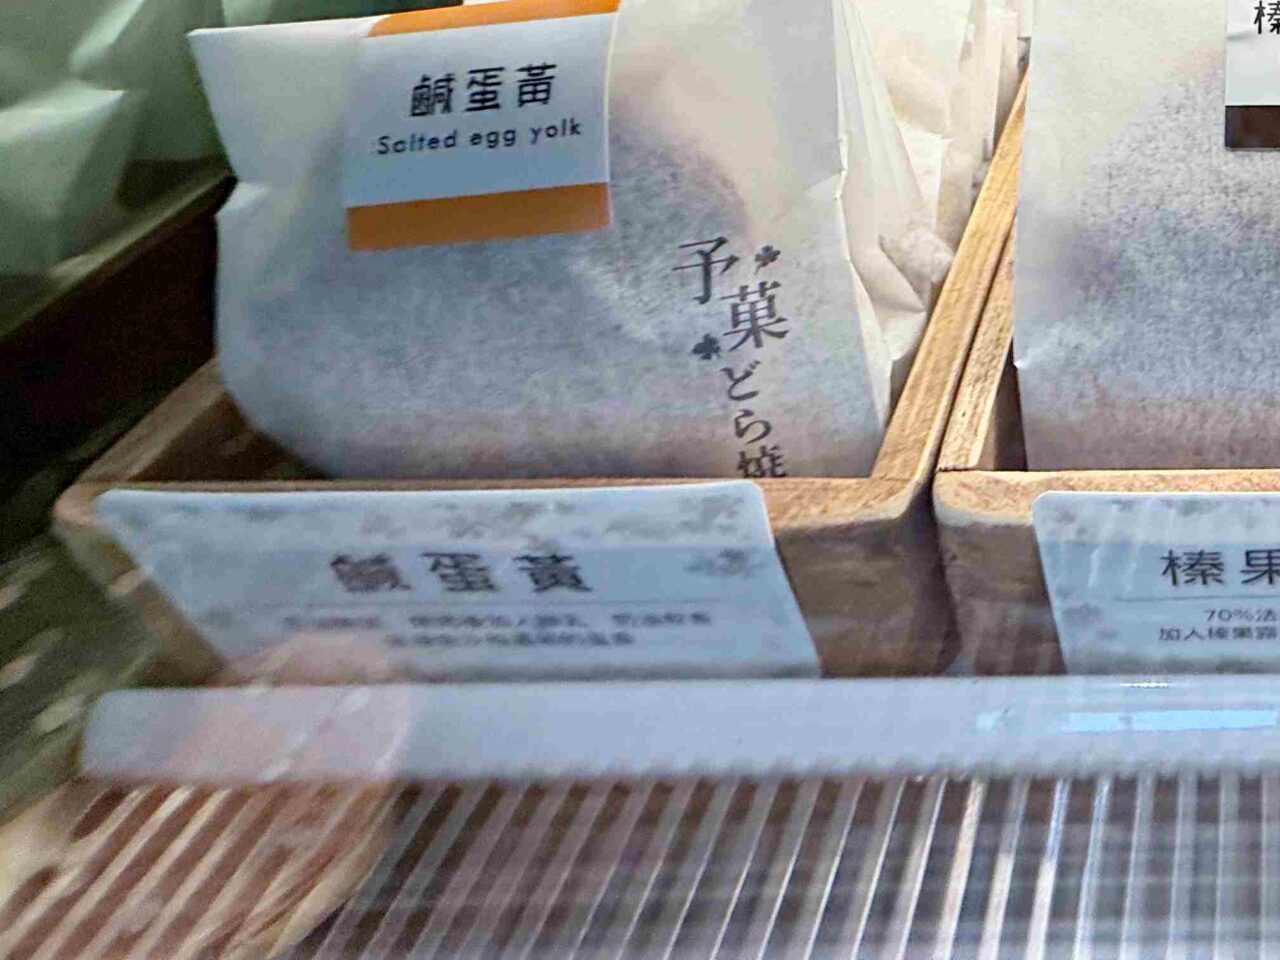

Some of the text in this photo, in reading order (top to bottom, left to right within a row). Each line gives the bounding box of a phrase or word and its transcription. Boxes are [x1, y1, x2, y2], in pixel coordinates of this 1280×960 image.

[409, 62, 558, 118] 鹹蛋黃
[376, 117, 582, 156] Salted egg yolk
[329, 551, 593, 594] 鹹蛋黃
